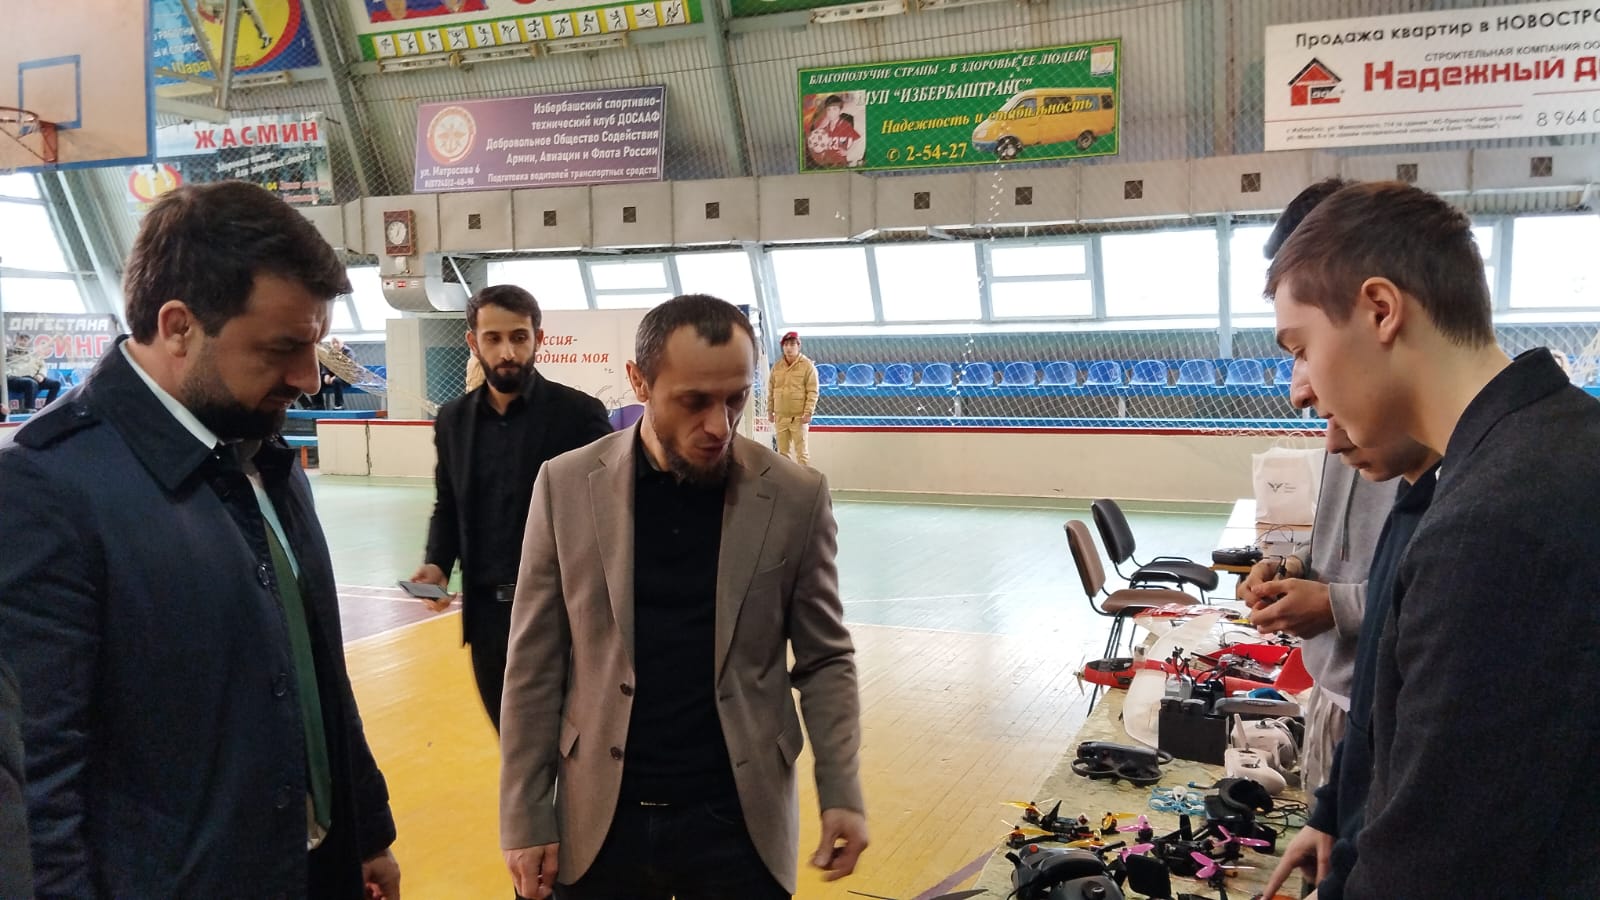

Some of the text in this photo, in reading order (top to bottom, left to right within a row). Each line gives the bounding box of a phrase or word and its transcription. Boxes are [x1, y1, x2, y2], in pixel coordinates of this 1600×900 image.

[1296, 29, 1384, 49] Продажа
[1391, 23, 1473, 41] квартир
[1480, 20, 1489, 32] в
[1424, 47, 1513, 62] СТРОИТЕЛЬНАЯ
[1516, 41, 1580, 56] КОМПАНИЯ
[809, 69, 891, 85] БЛАГОПОЛУЧИЕ
[894, 64, 939, 78] СТРАНЫ
[949, 63, 957, 74] В
[960, 56, 1019, 73] ЗДОРОВЬЕ
[1021, 54, 1036, 66] ЕЕ
[1037, 48, 1088, 65] ЛЮДЕЙ!
[1364, 56, 1600, 93] Надежный Д
[533, 97, 661, 115] Избербашский спортивно-
[532, 111, 660, 130] технический клуб ДОСААФ
[881, 113, 970, 134] Надежность
[974, 112, 983, 124] и
[1536, 111, 1548, 127] 8
[1553, 110, 1587, 126] 964
[194, 121, 319, 149] ЖАСМИН
[486, 128, 659, 151] Добровольное Общество Содействия
[540, 151, 581, 165] Авиации
[583, 151, 589, 159] и
[591, 147, 621, 159] Флота
[623, 146, 658, 157] России
[905, 142, 967, 161] 2-54-27
[571, 167, 624, 178] транспортных
[8, 317, 109, 331] ДАГЕСТАНА
[34, 335, 110, 358] СИНГ
[542, 335, 578, 346] ссия-
[535, 350, 609, 364] одина моя
